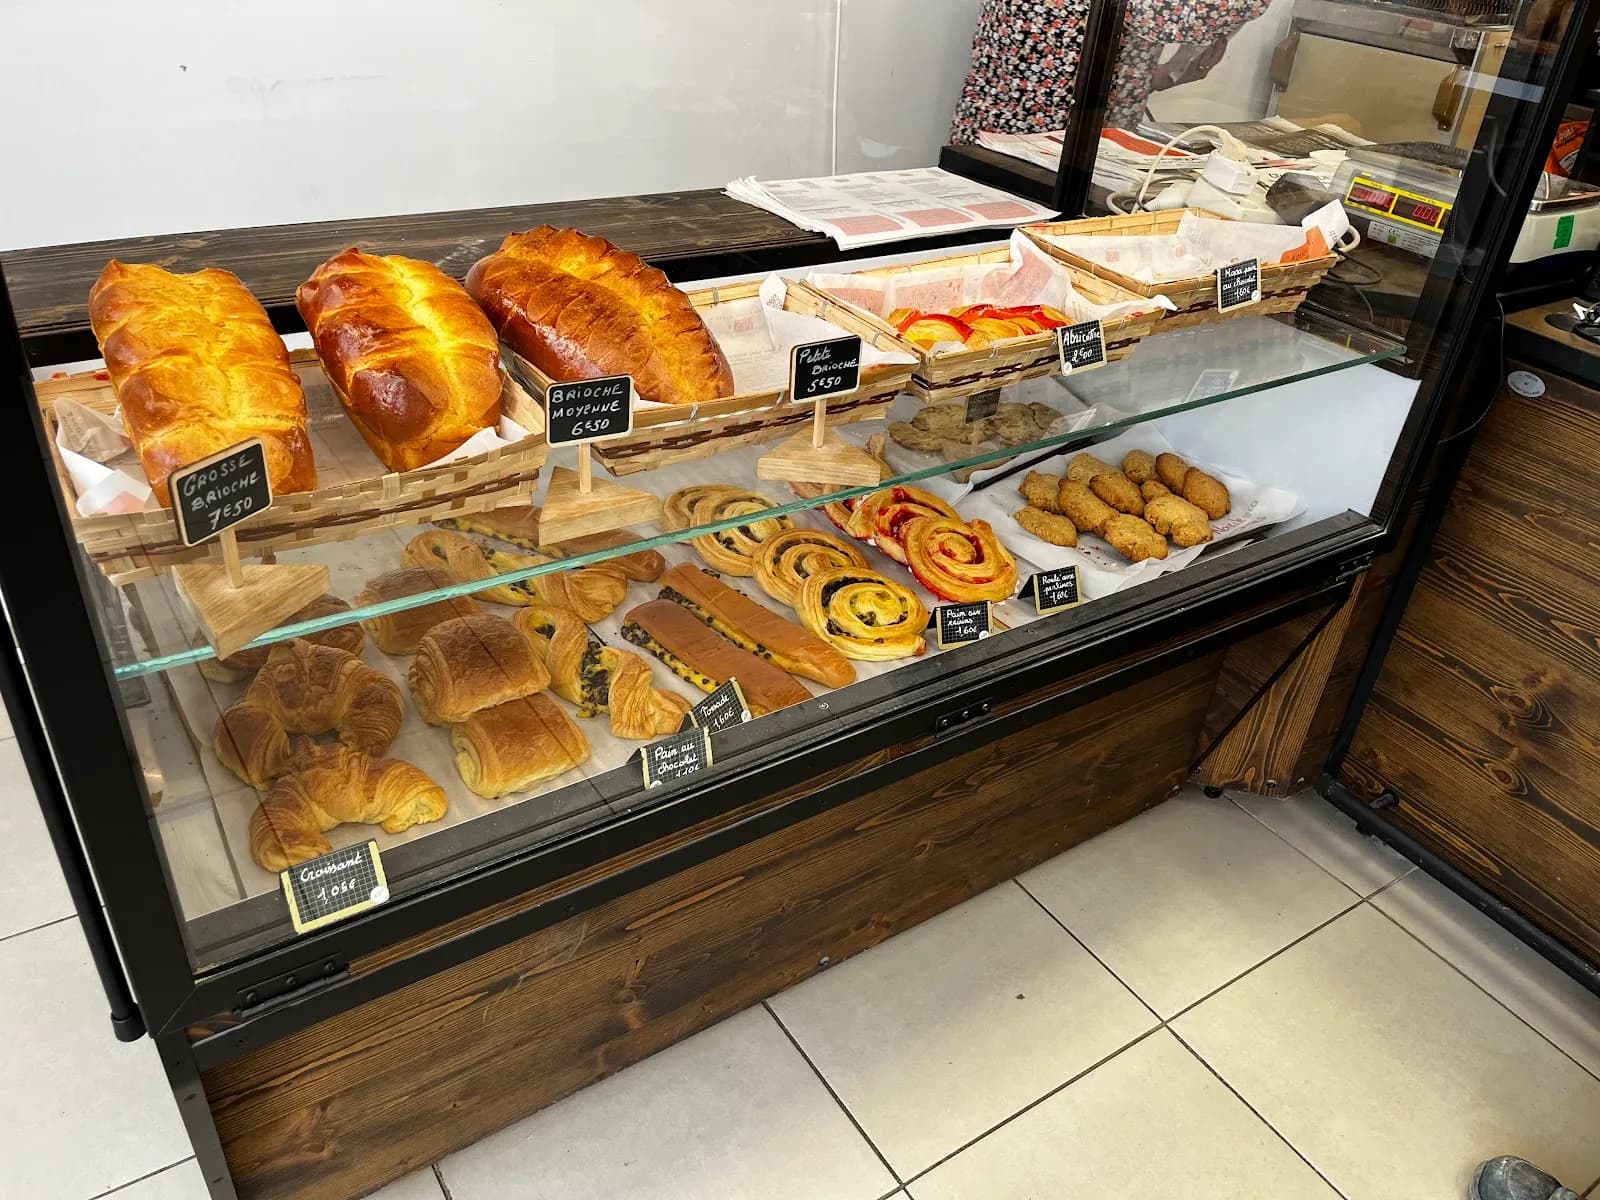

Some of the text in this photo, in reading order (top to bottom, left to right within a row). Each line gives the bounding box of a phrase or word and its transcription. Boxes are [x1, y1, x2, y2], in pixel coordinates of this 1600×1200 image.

[1222, 282, 1232, 291] au
[551, 400, 622, 420] MOYENNE
[183, 453, 255, 497] GROSSE
[946, 608, 966, 618] Pain
[654, 742, 695, 761] Pain au
[657, 752, 699, 775] chocolat
